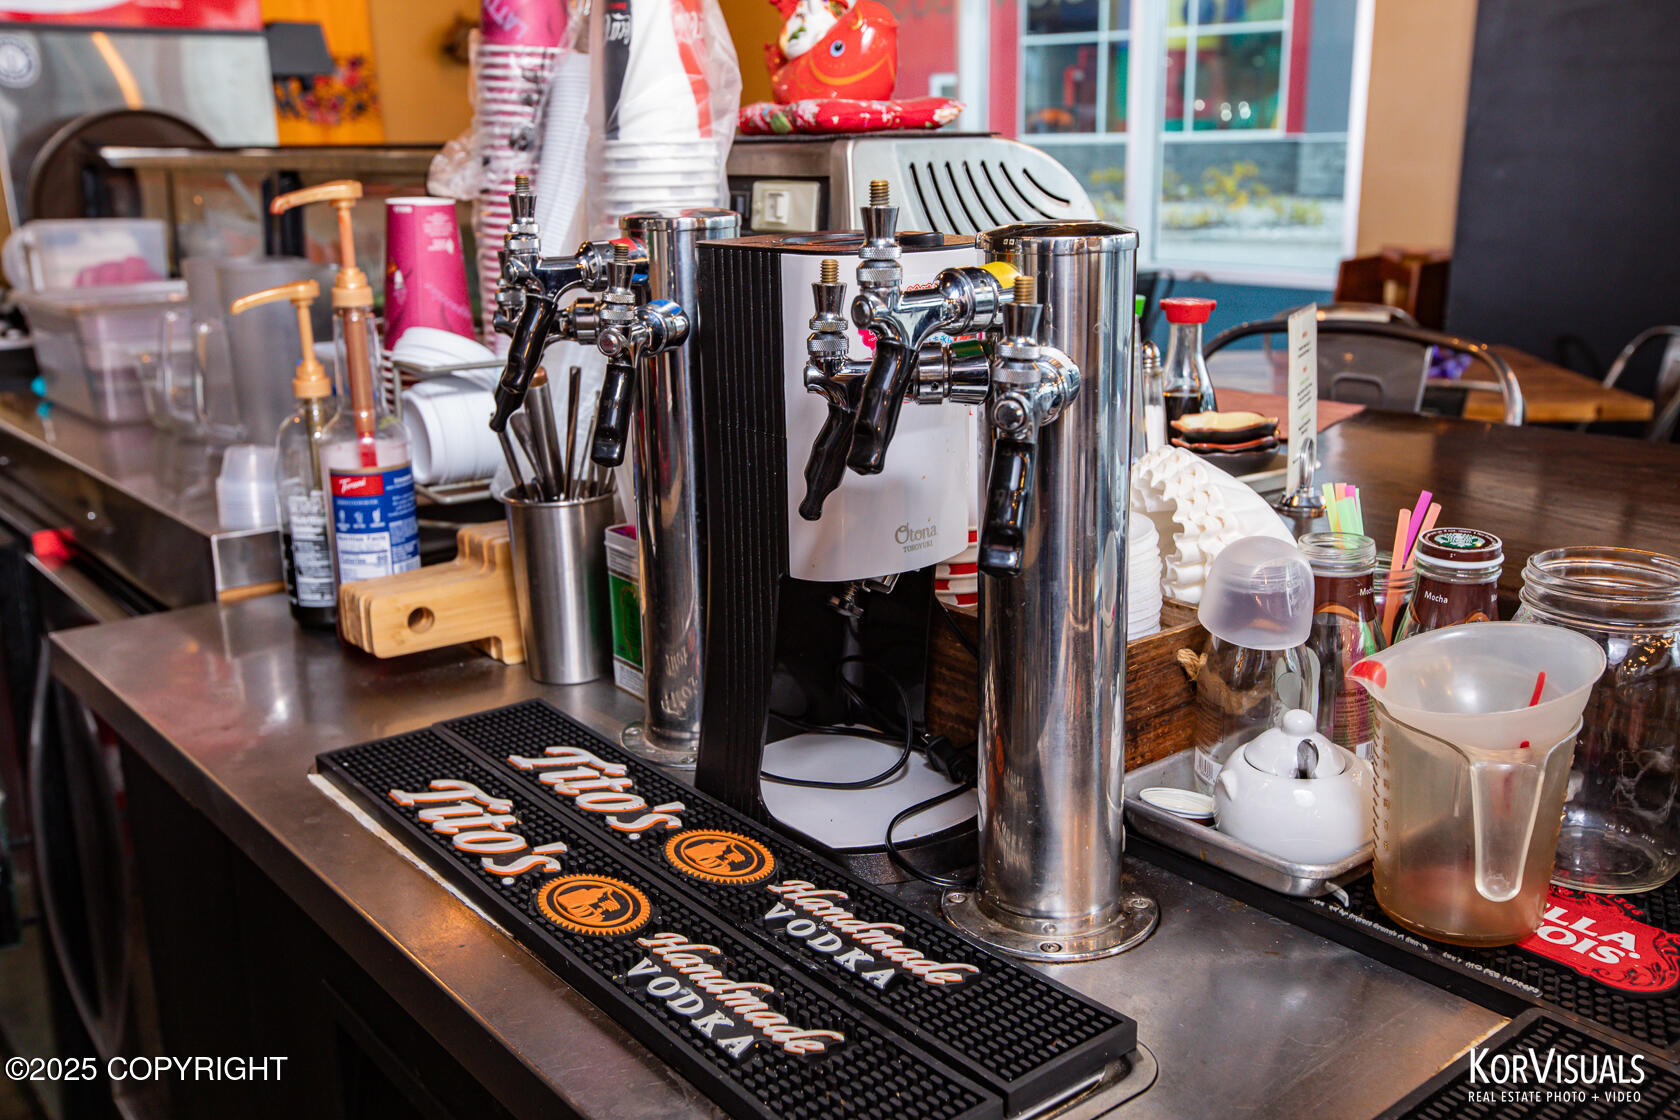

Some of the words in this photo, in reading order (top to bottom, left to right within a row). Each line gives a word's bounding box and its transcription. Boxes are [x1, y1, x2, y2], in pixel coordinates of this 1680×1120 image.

[895, 521, 937, 545] Otona
[1424, 590, 1449, 604] Mocha
[764, 902, 896, 989] VODKA
[767, 879, 981, 985] Handmade
[1536, 922, 1626, 964] OIS
[1543, 903, 1636, 952] LLA
[627, 957, 755, 1058] VODKA
[636, 932, 845, 1054] Handmade
